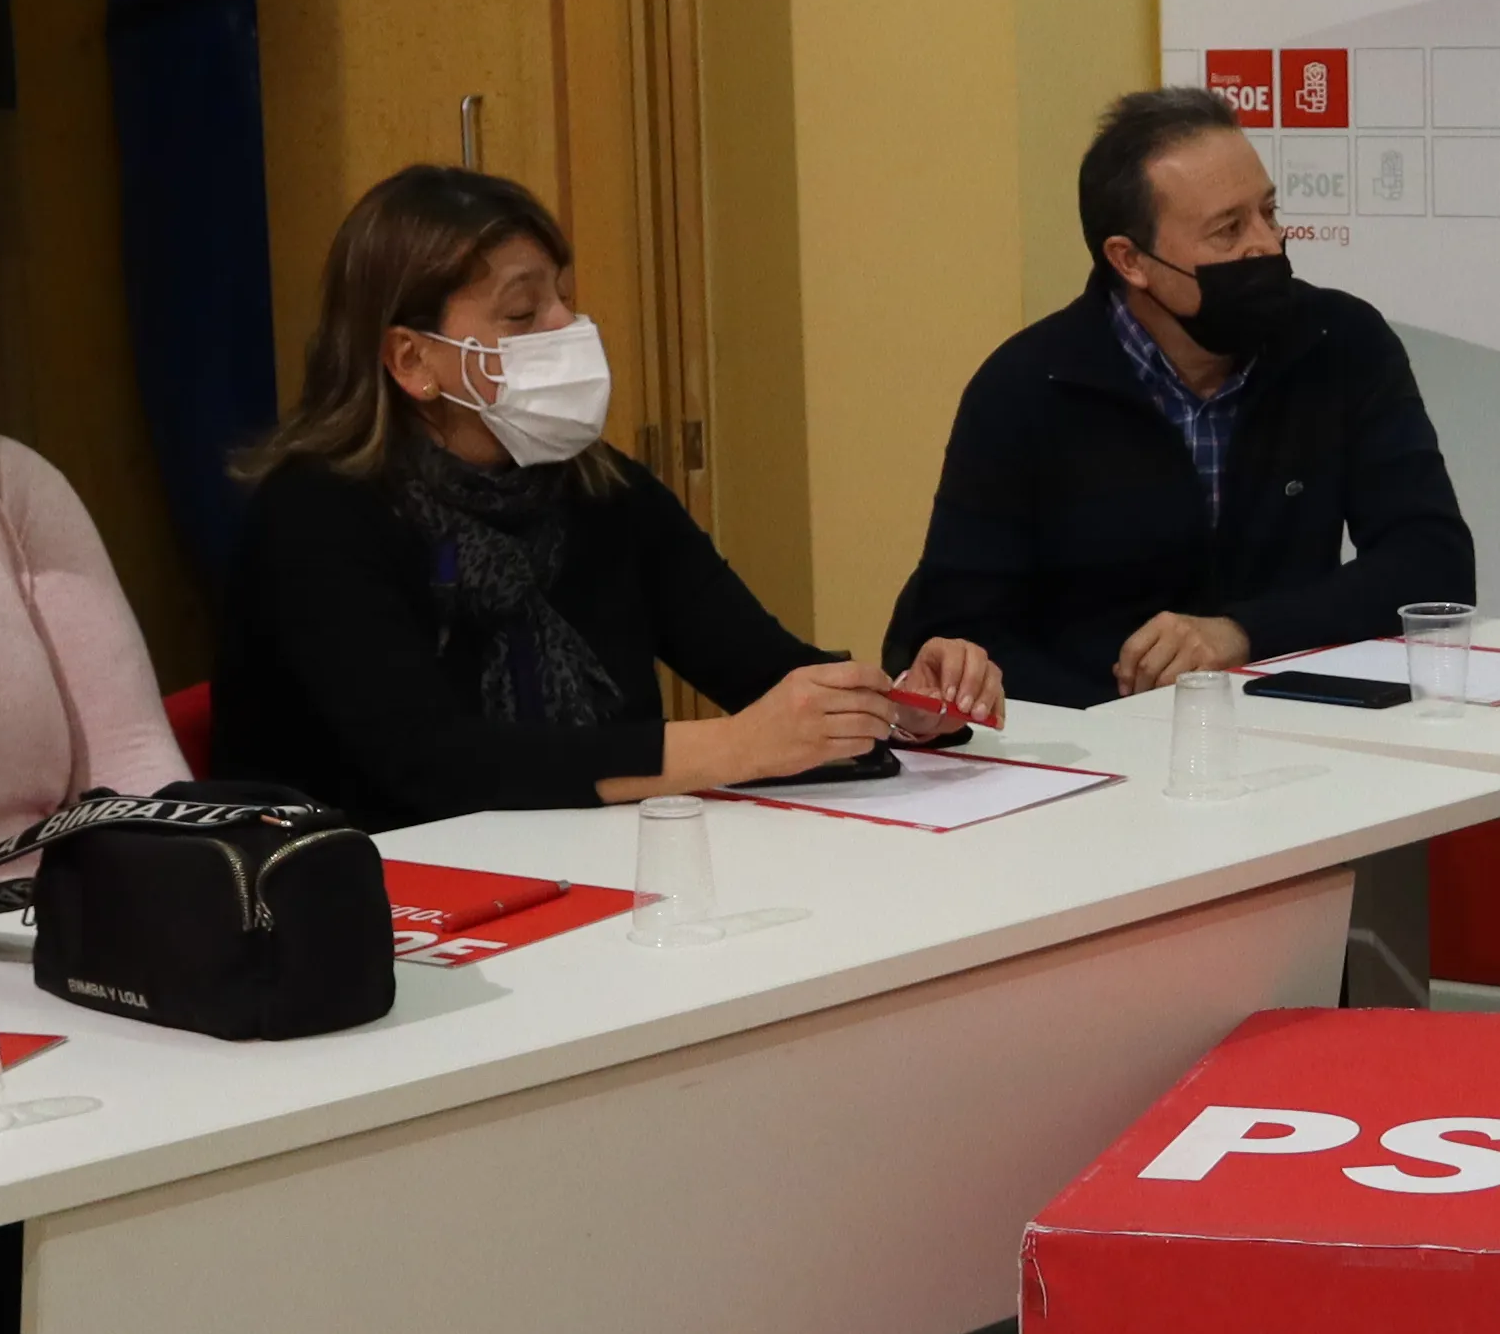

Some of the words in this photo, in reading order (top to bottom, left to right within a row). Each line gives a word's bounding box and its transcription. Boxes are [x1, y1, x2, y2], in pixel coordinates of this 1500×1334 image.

[1287, 173, 1345, 198] PSOE
[36, 800, 163, 841] BIMBA
[167, 803, 191, 821] Y
[67, 978, 108, 999] BIMBA
[107, 987, 116, 1001] Y
[117, 989, 149, 1009] LOLA
